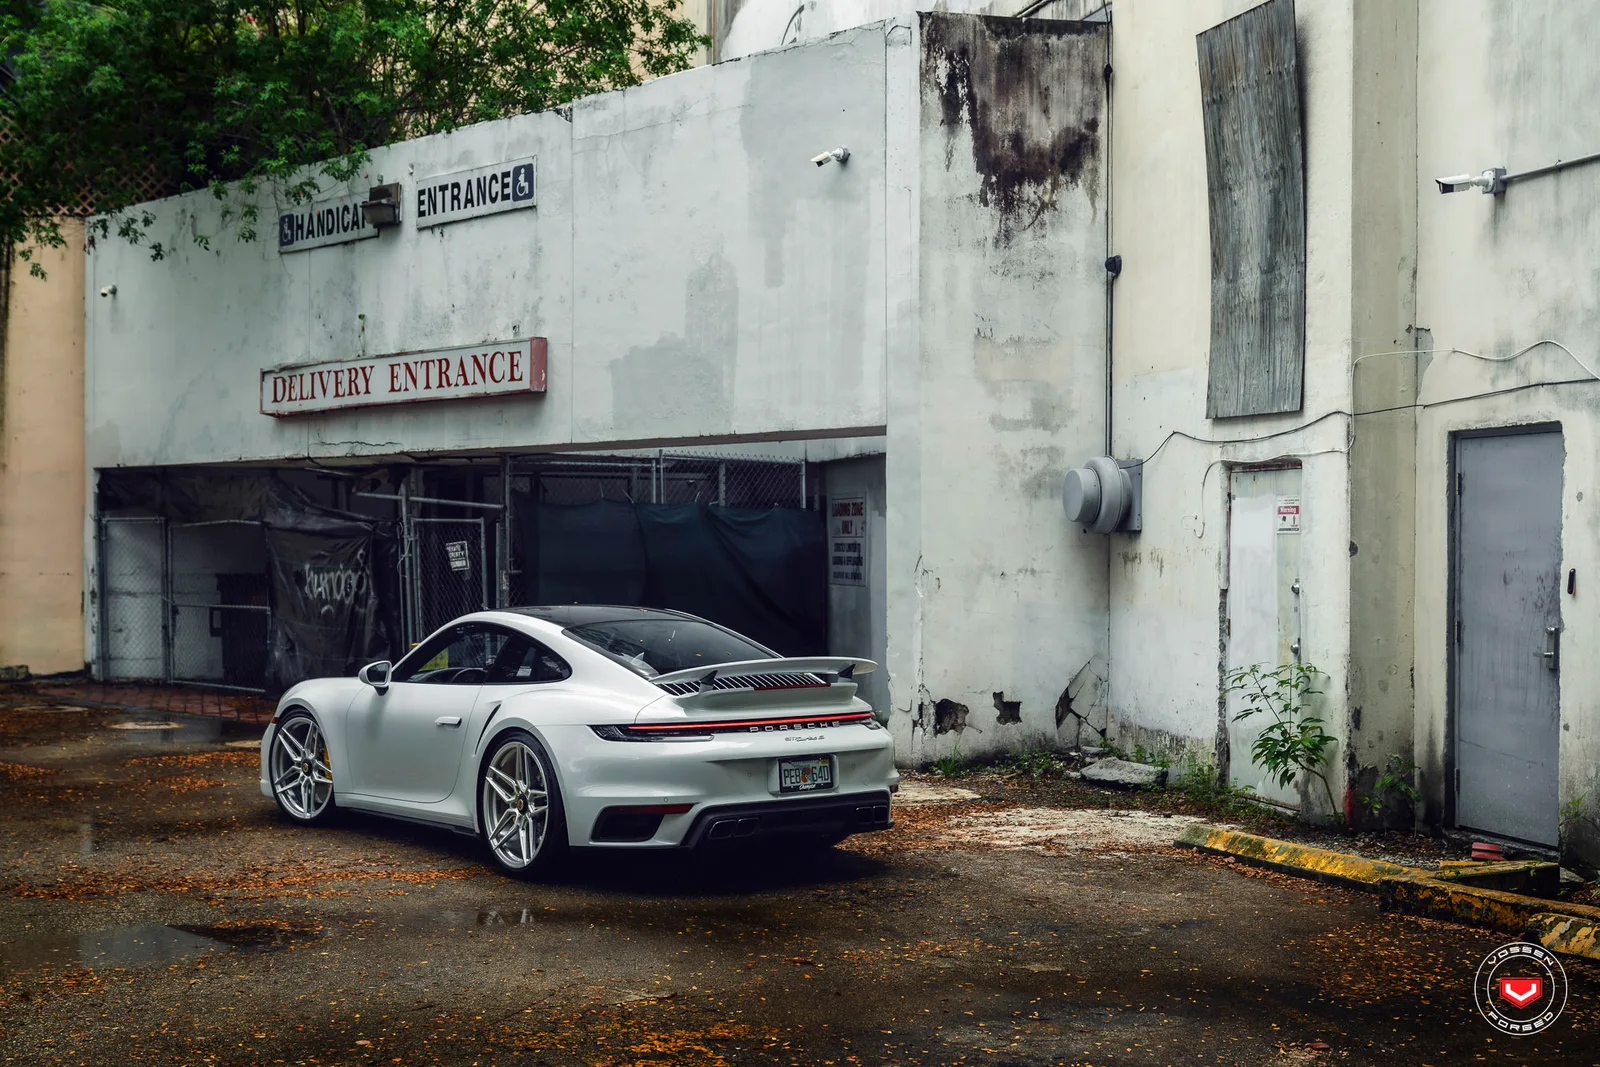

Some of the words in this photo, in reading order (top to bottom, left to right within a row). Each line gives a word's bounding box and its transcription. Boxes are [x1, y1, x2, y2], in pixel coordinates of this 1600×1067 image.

[417, 171, 512, 218] ENTRANCE
[271, 365, 375, 404] DELIVERY
[388, 351, 523, 393] ENTRANCE
[832, 503, 850, 516] LOADING
[851, 502, 863, 516] ZONE
[842, 520, 852, 534] ONLY
[750, 721, 840, 733] PORSCHE
